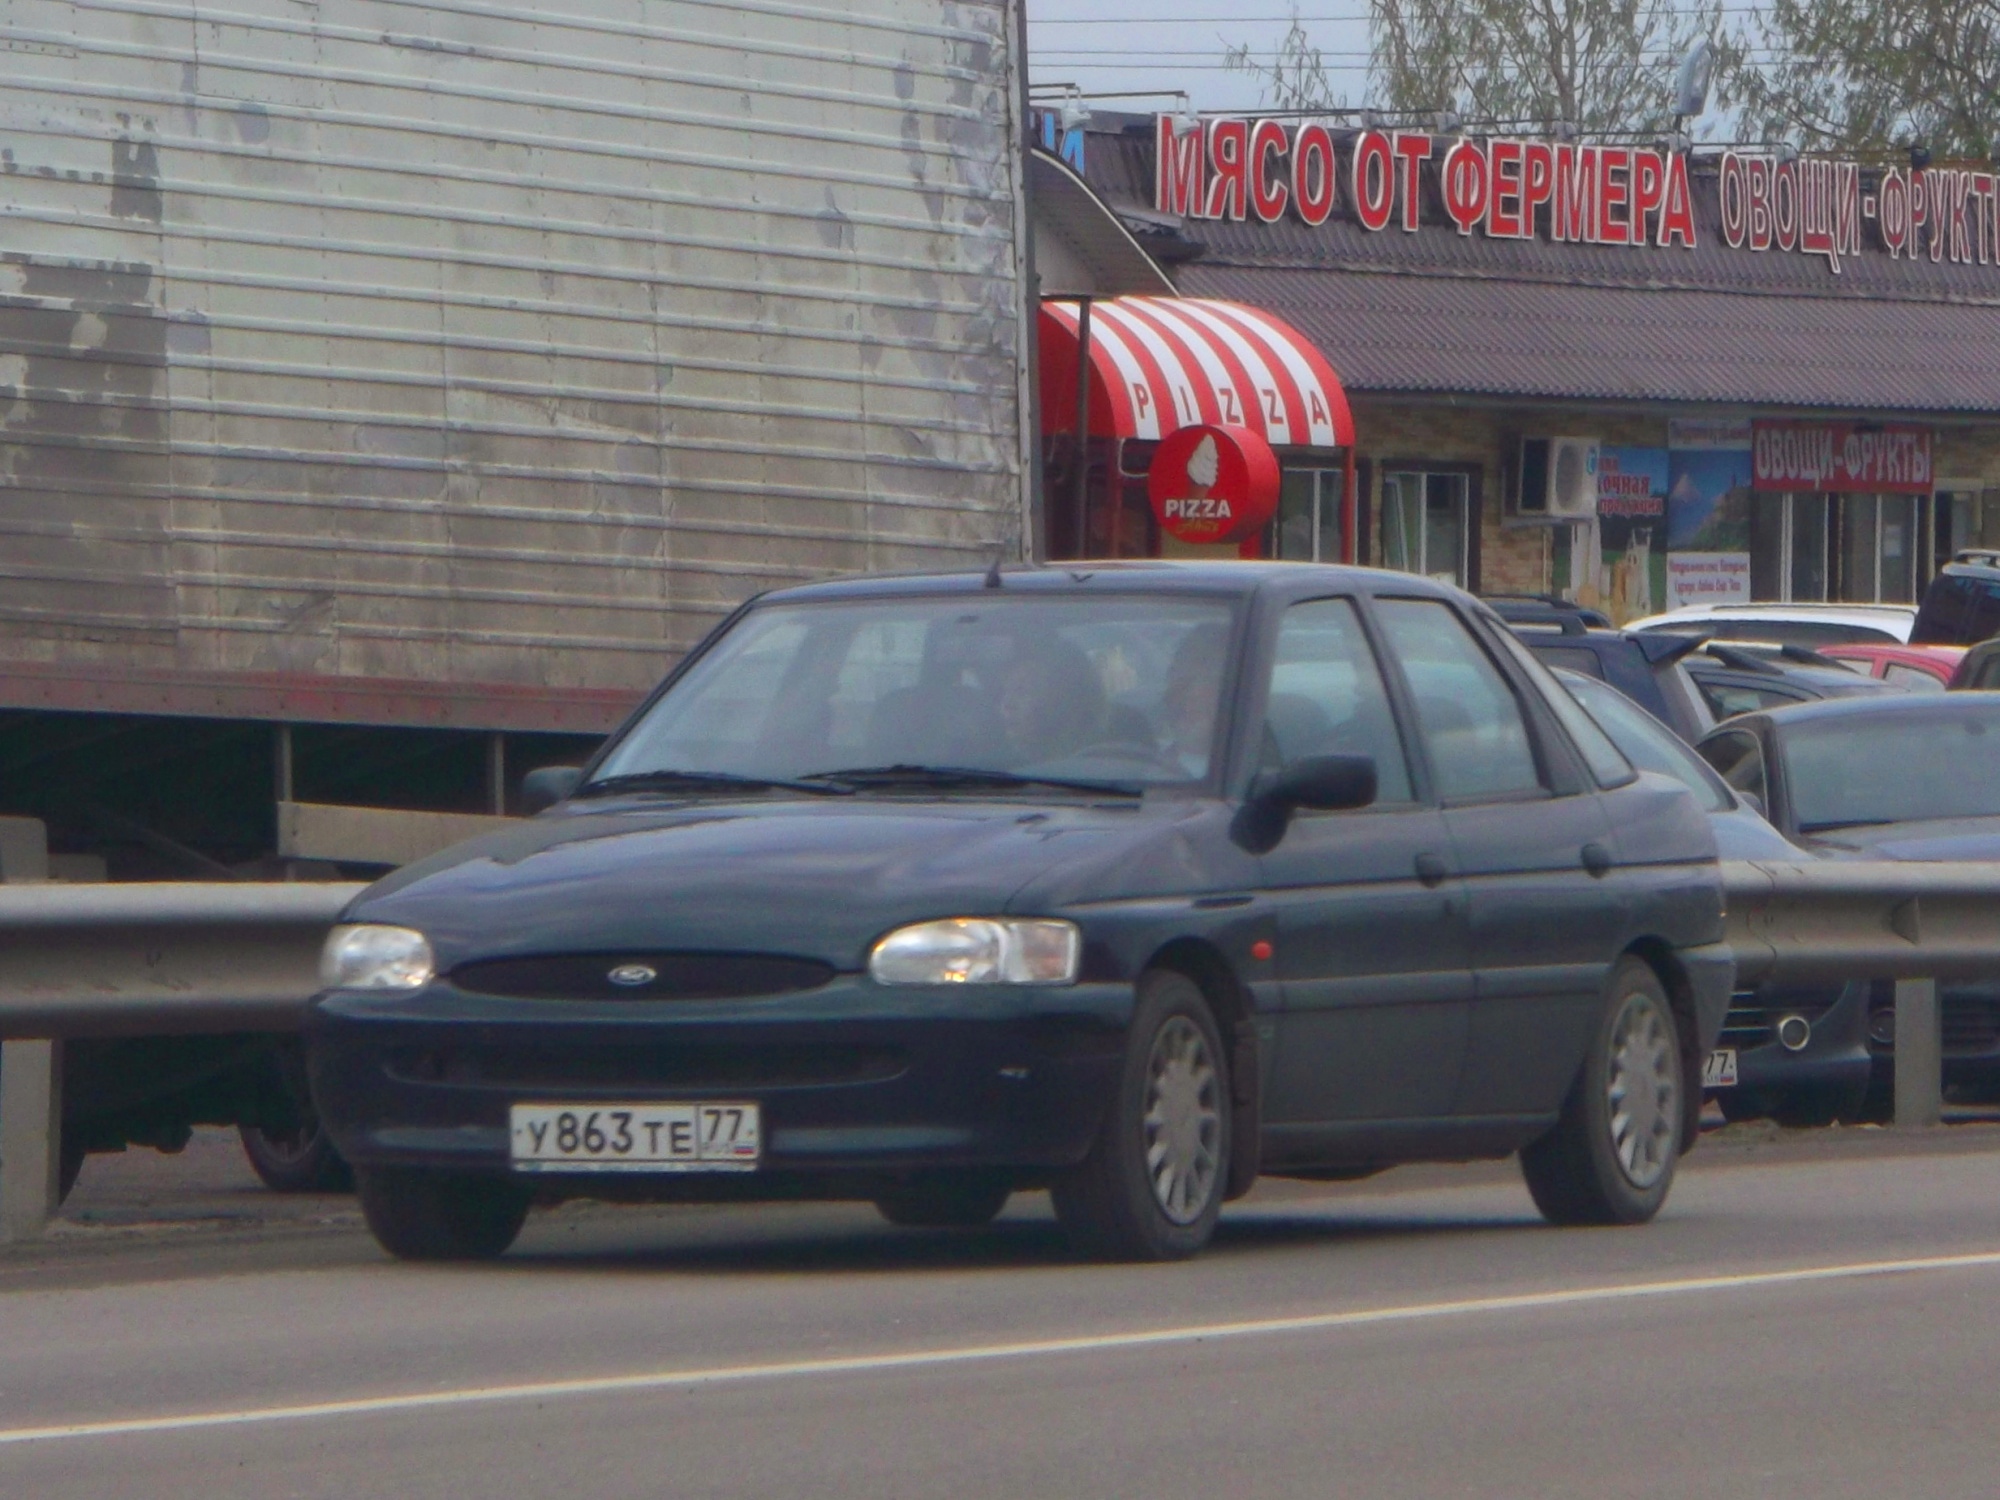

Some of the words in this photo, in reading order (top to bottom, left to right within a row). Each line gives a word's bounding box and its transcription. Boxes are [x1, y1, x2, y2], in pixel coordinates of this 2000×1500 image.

[1156, 113, 1335, 226] МЯСО
[1352, 130, 1431, 232] ОТ
[1441, 138, 1697, 248] ФЕРМЕРА
[1134, 381, 1329, 426] PIZZA
[1756, 428, 1930, 491] ОВОЩИ-ФРУКТЫ
[1165, 499, 1232, 518] PIZZA
